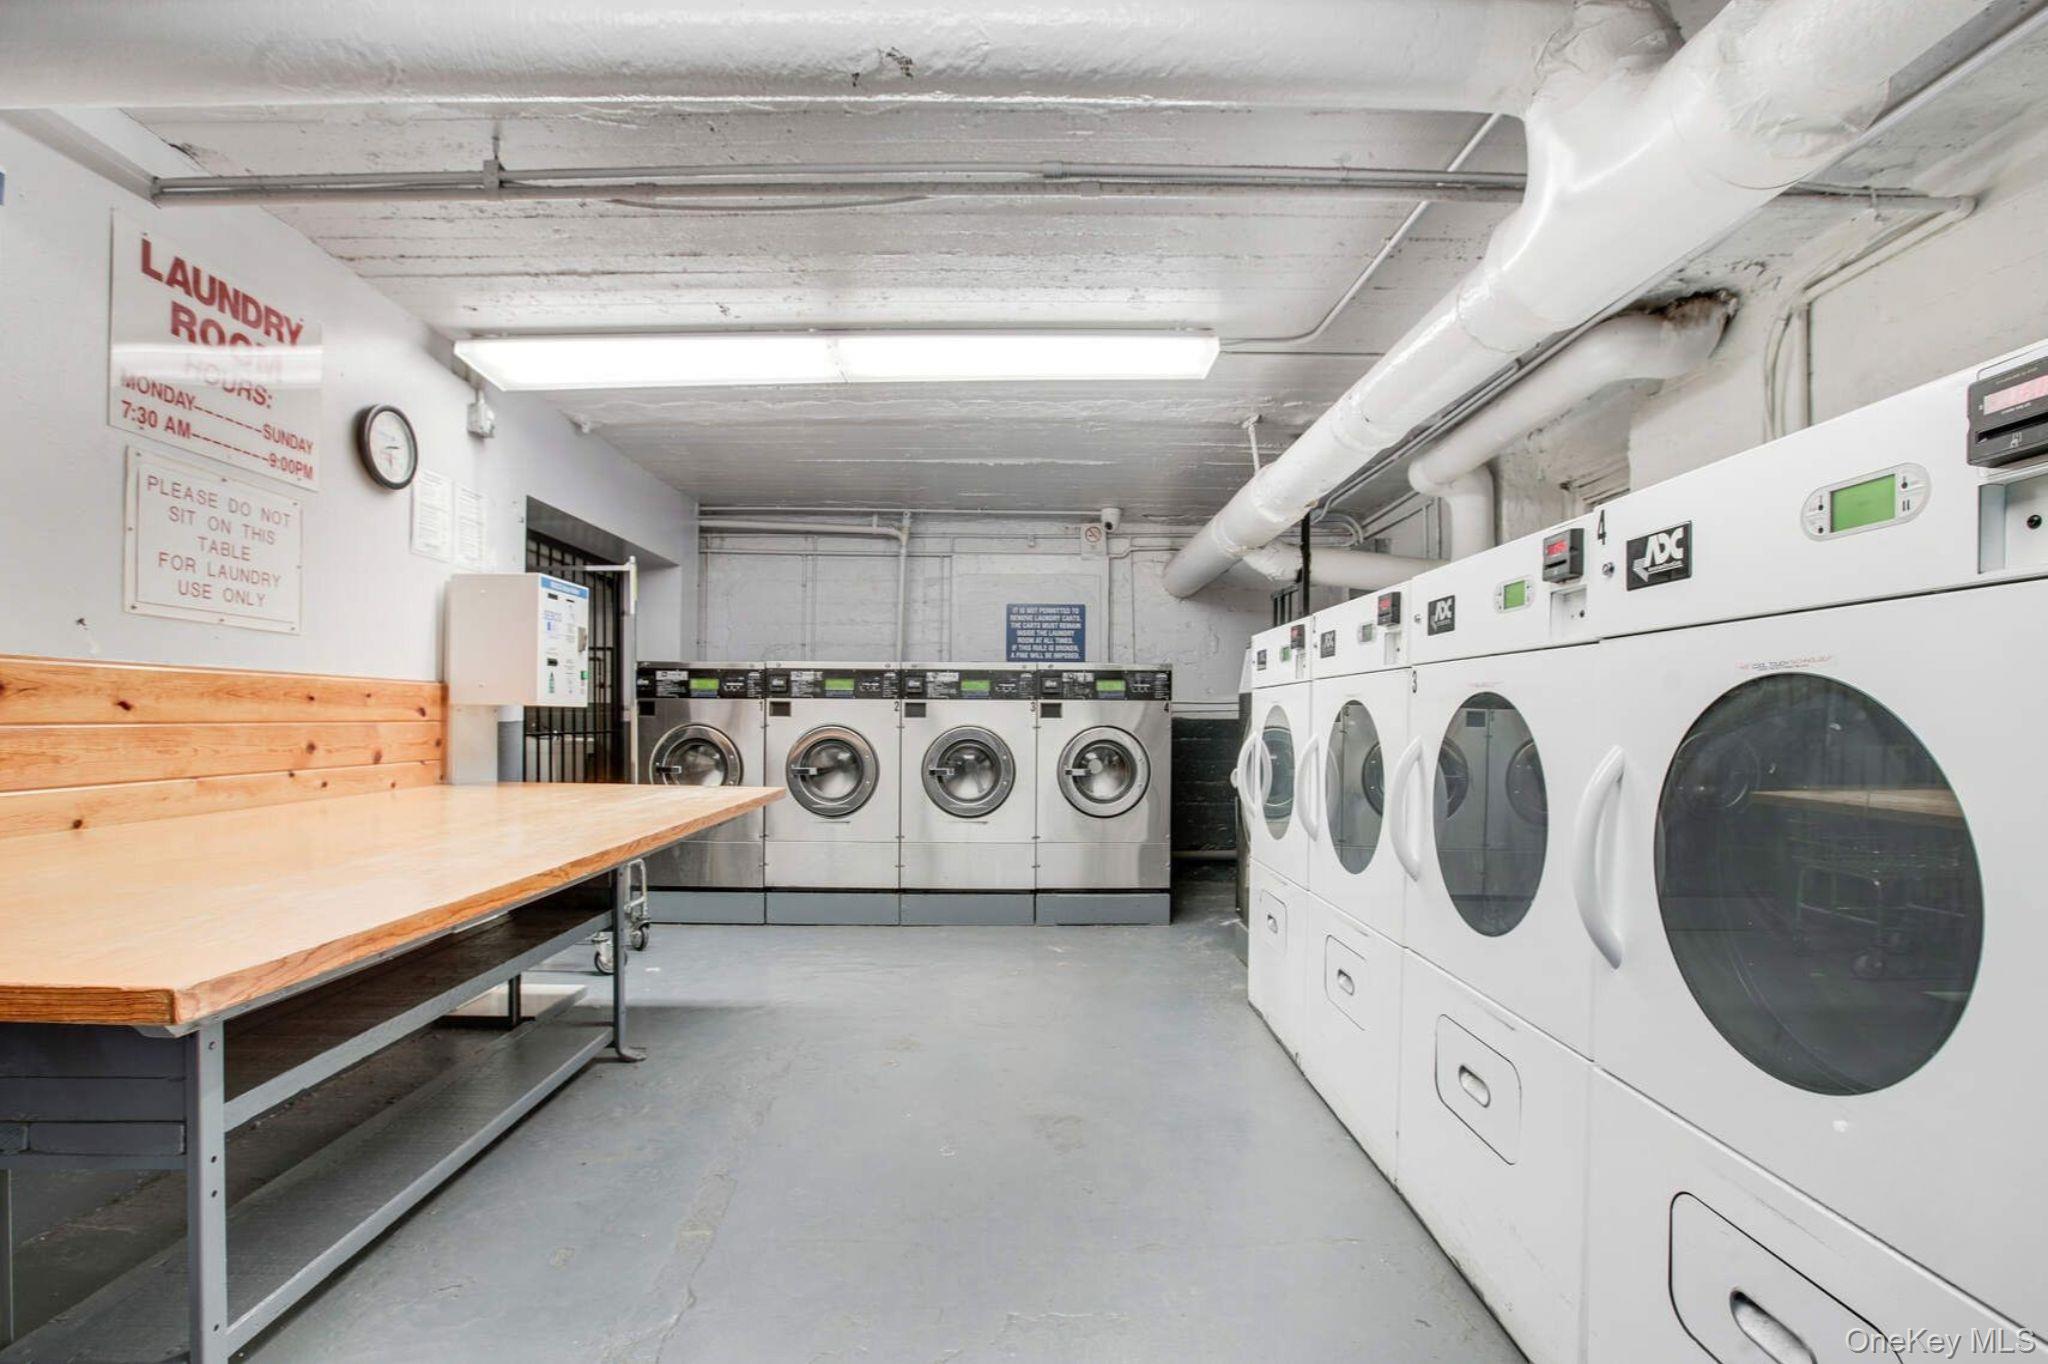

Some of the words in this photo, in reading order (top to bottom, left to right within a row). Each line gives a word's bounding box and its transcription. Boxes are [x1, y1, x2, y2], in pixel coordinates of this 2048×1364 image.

[141, 238, 304, 346] LAUNDRY
[121, 369, 196, 411] MONDAY
[263, 424, 314, 456] SUNDAY
[121, 400, 158, 428] 7:30
[164, 416, 191, 439] AM
[269, 453, 313, 481] 9:00PM
[147, 475, 218, 509] PLEASE
[228, 498, 250, 516] DO
[261, 507, 290, 527] NOT
[169, 506, 196, 525] SIT
[208, 516, 231, 534] ON
[242, 523, 276, 545] THIS
[1597, 509, 1606, 545] 4
[198, 536, 251, 561] TABLE
[1644, 526, 1684, 568] ADC
[159, 551, 196, 573] FOR
[208, 562, 281, 588] LAUNDRY
[178, 579, 212, 600] USE
[223, 588, 266, 607] ONLY
[1412, 670, 1417, 693] 3
[894, 701, 899, 712] 2
[1030, 702, 1036, 712] 3
